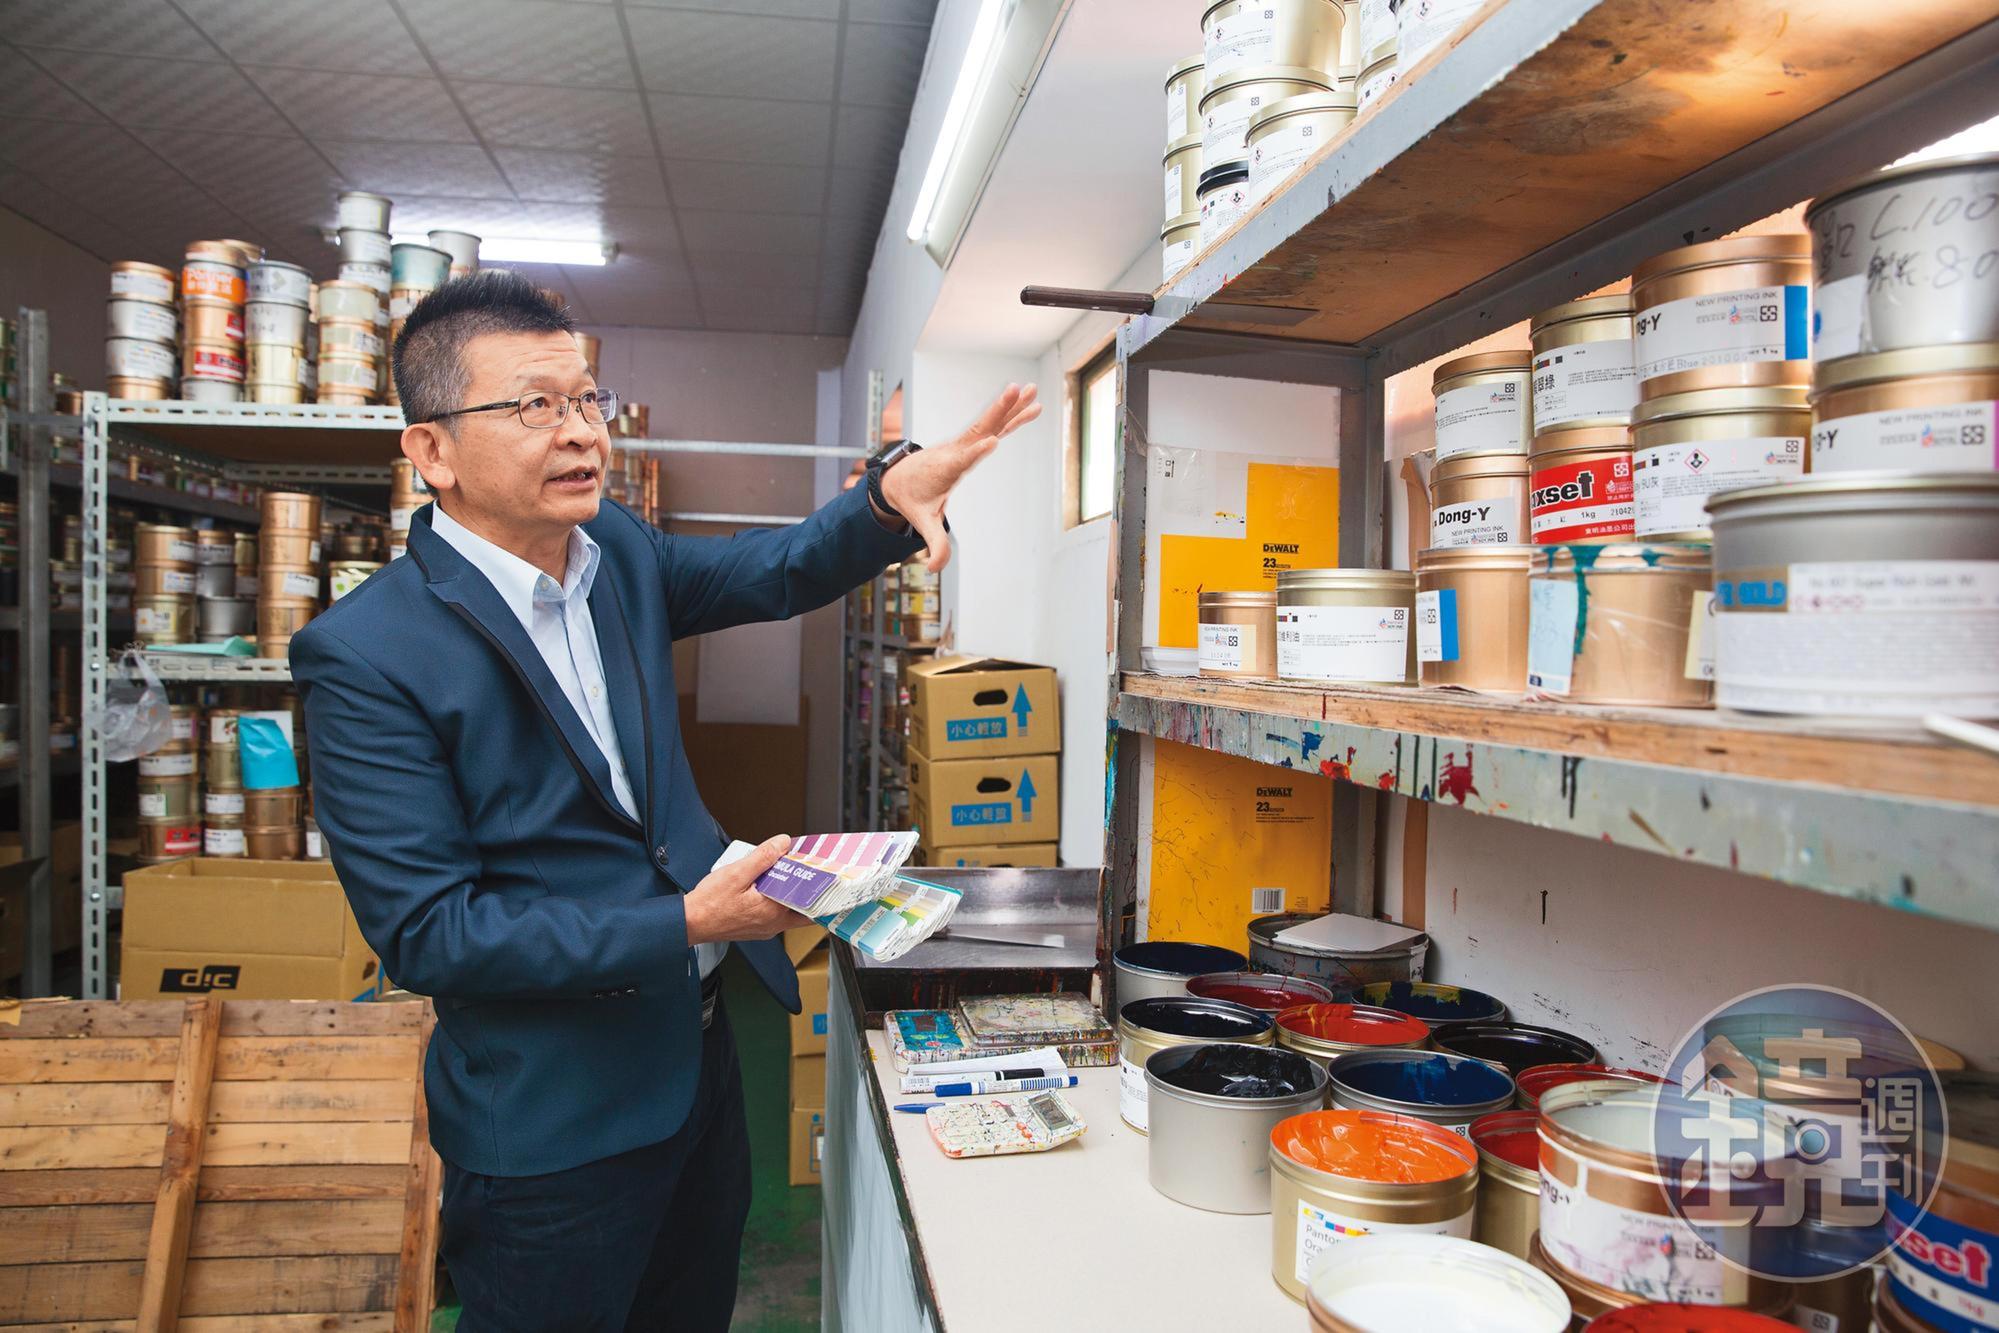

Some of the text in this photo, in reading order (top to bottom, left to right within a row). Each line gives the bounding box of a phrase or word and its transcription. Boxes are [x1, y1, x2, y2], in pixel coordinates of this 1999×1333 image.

[1695, 291, 1777, 307] NEW PRINTING INK
[1439, 506, 1490, 526] Dong-Y
[1263, 557, 1276, 568] 23
[1256, 801, 1270, 812] 23
[793, 867, 817, 881] GUIDE
